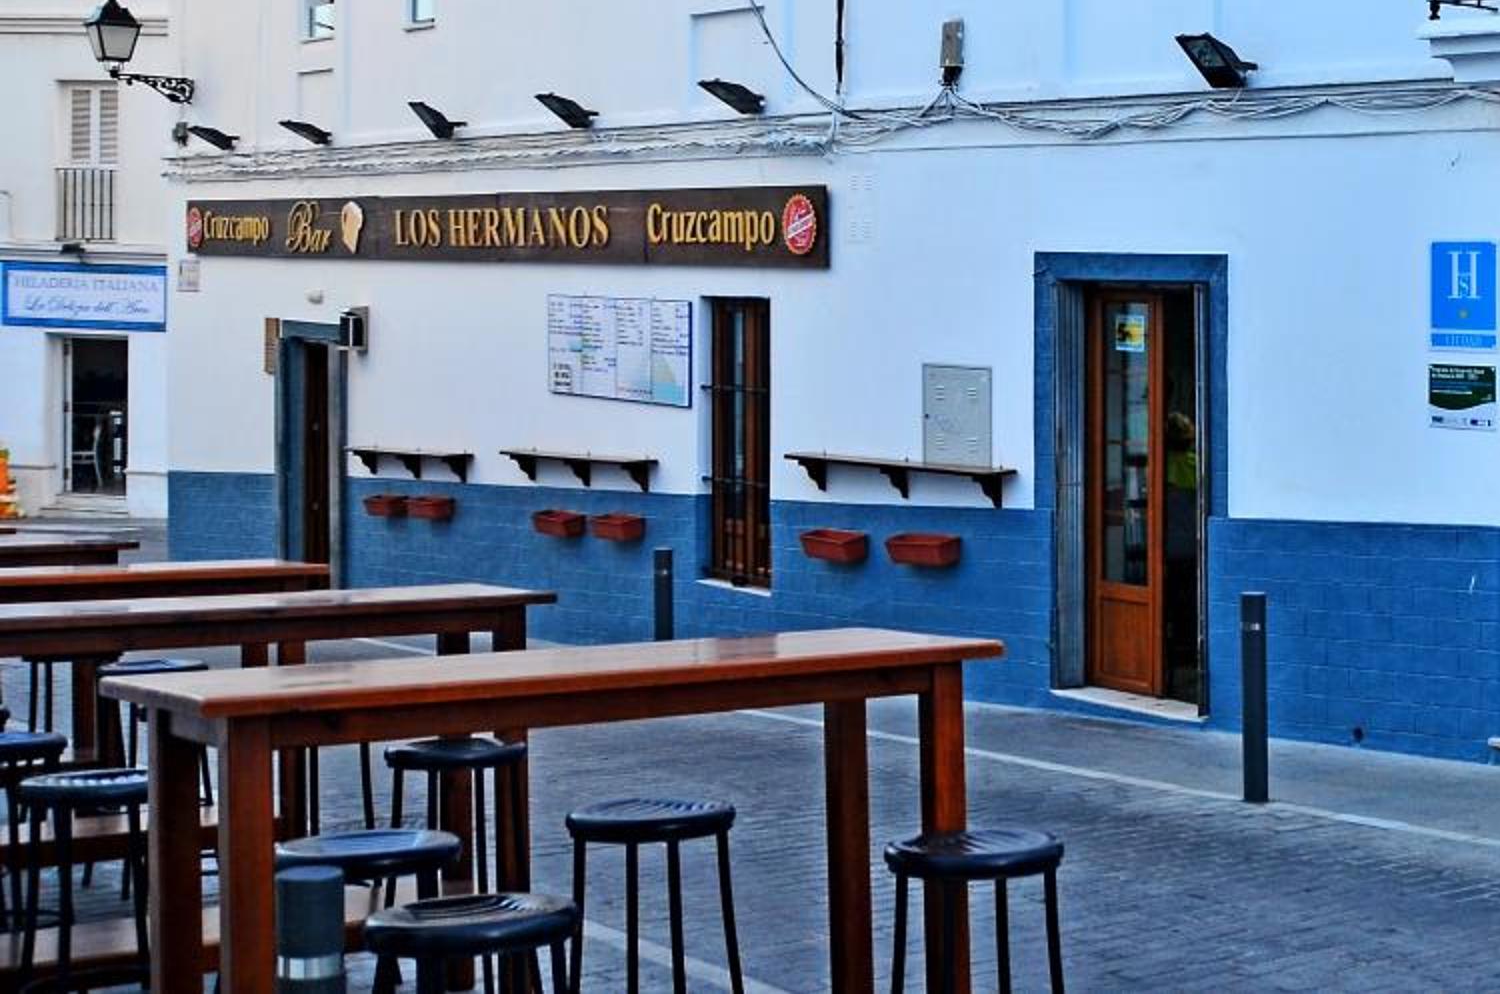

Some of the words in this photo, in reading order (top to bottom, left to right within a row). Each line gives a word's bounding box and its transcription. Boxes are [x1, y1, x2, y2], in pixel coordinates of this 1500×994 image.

[204, 210, 270, 246] Cruzcampo
[285, 201, 333, 253] Bar
[394, 209, 442, 247] LOS
[447, 205, 610, 248] HERMANOS
[646, 202, 776, 251] Cruzcampo
